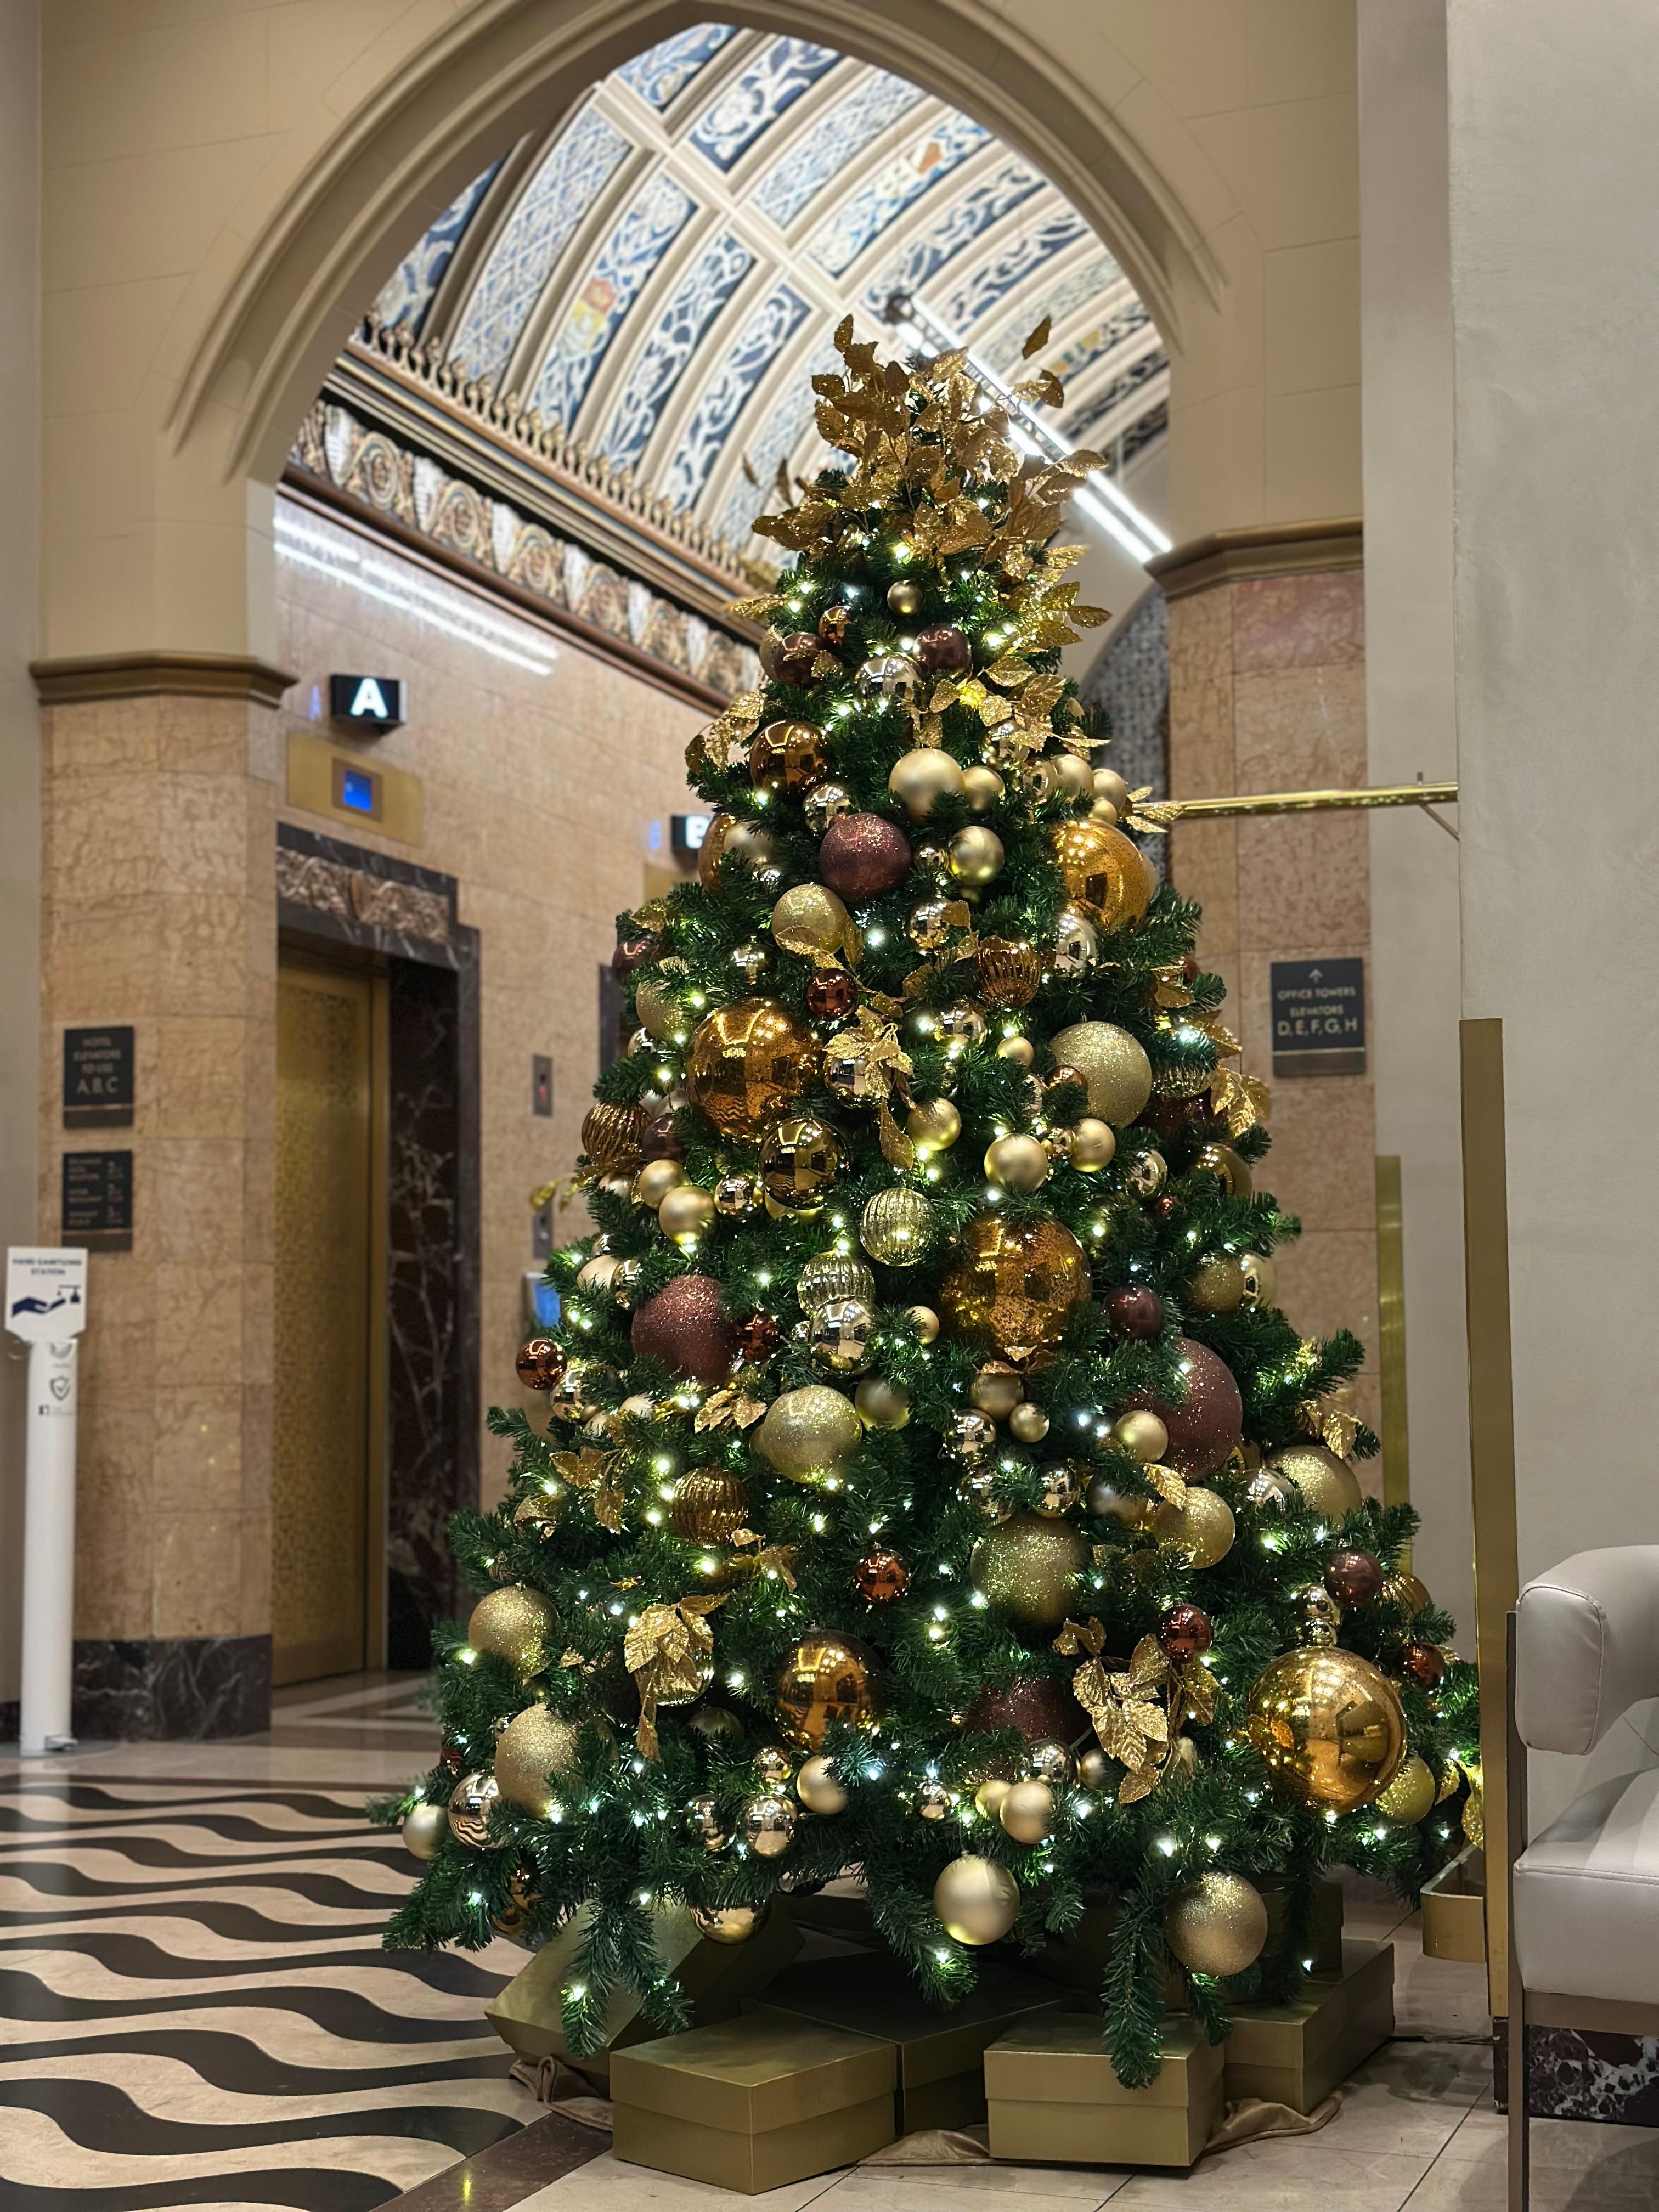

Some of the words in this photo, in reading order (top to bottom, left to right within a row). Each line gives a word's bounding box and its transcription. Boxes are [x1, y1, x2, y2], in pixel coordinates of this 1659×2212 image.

[350, 677, 388, 718] A
[1277, 989, 1312, 1000] OFFICE
[1315, 986, 1356, 998] TOWERS
[1290, 1005, 1343, 1017] ELEVATORS
